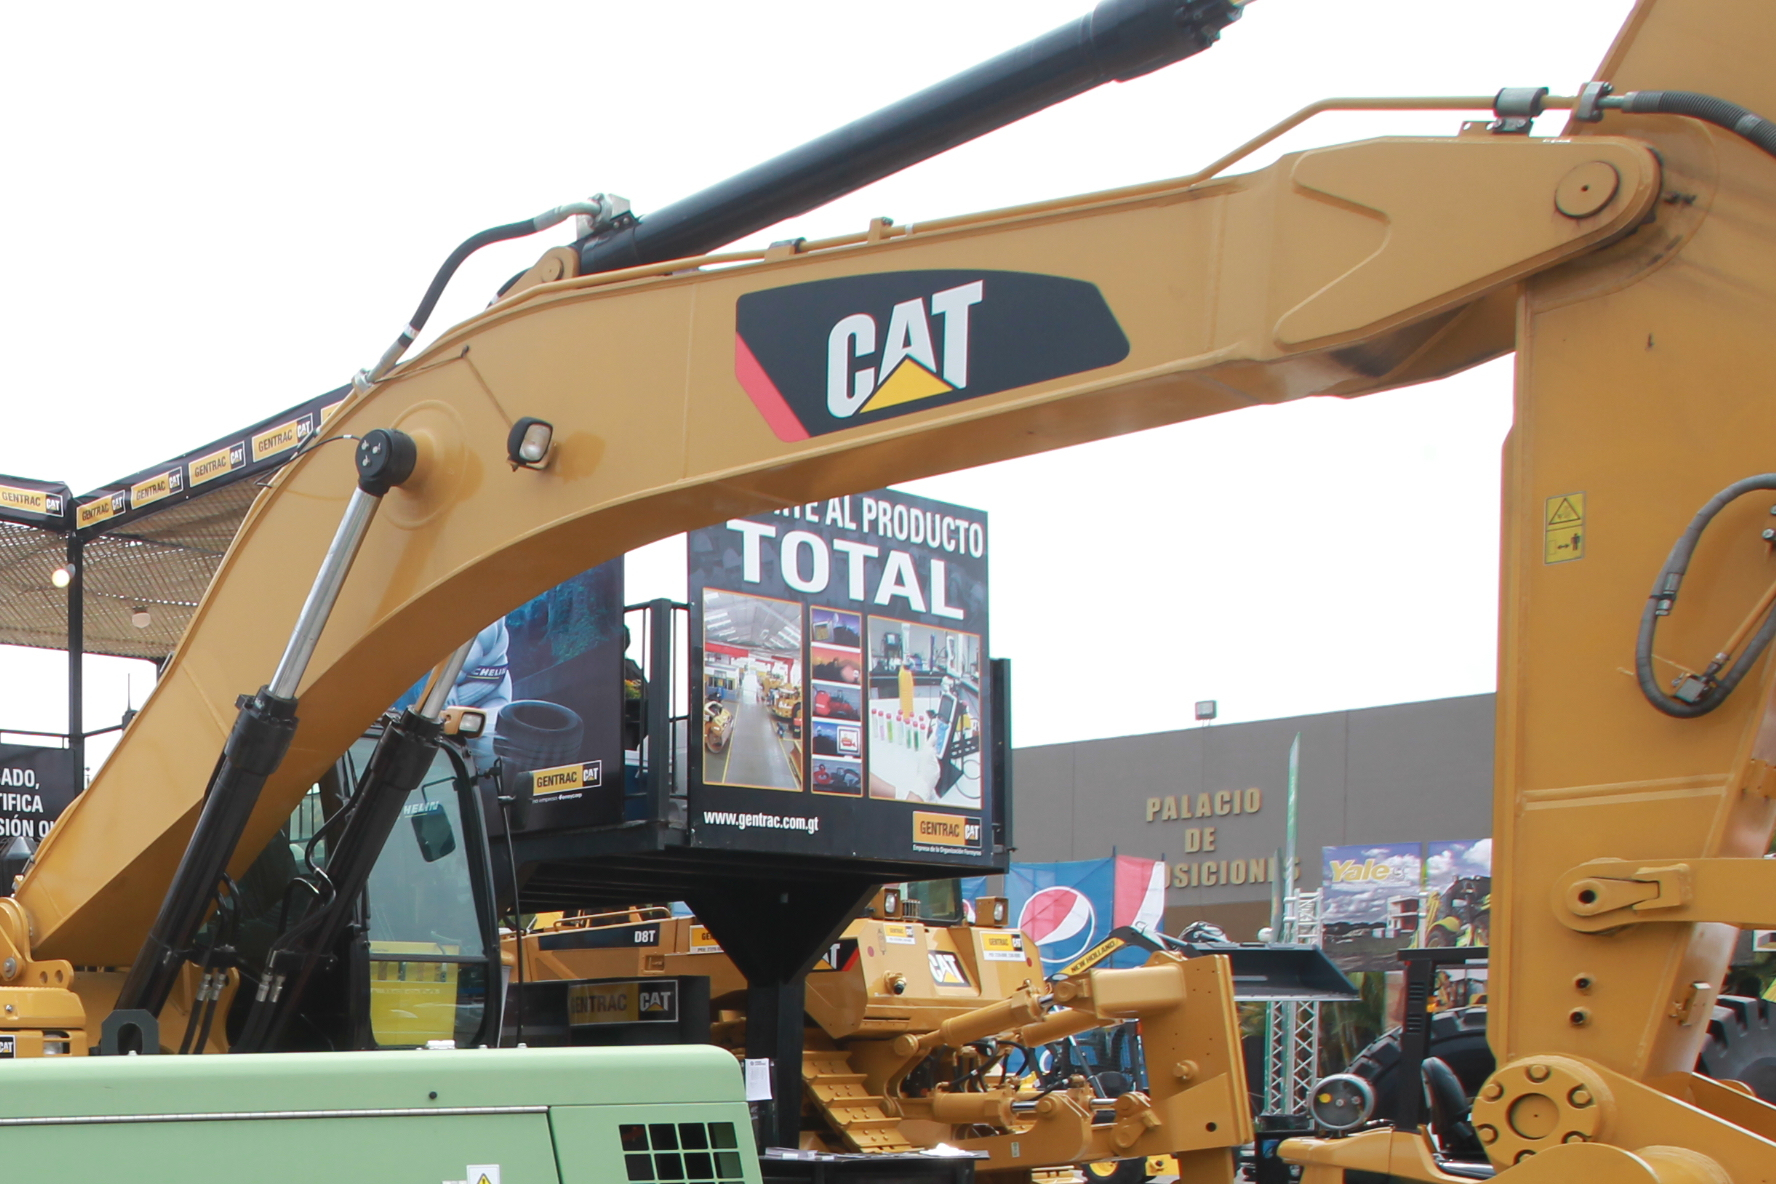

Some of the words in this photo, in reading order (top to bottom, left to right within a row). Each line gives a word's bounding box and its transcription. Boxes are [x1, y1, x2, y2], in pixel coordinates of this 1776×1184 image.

[826, 279, 984, 419] CAT
[258, 431, 294, 453] GENTRAC
[296, 419, 312, 439] CAT
[194, 456, 227, 479] GENTRAC
[230, 447, 243, 465] CAT
[1, 491, 42, 508] GENTRAC
[46, 497, 61, 513] CAT
[136, 480, 166, 501] GENTRAC
[168, 475, 181, 490] CAT
[82, 502, 110, 521] GENTRAC
[111, 496, 123, 511] CAT
[825, 494, 857, 531] AL
[862, 496, 984, 559] PRODUCTO
[726, 518, 964, 620] TOTAL
[536, 771, 578, 788] GENTRAC
[583, 767, 599, 782] CAT
[1145, 787, 1263, 823] PALACIO
[704, 811, 819, 835] www.gentrac.com.gt
[919, 820, 960, 838] GENTRAC
[964, 824, 980, 841] CAT
[1184, 826, 1216, 854] DE
[1329, 859, 1392, 883] Yale
[634, 930, 656, 943] D8T
[928, 953, 964, 984] CAT
[1070, 958, 1088, 974] NEW
[1086, 940, 1116, 962] HOLLAND
[639, 991, 672, 1013] CAT
